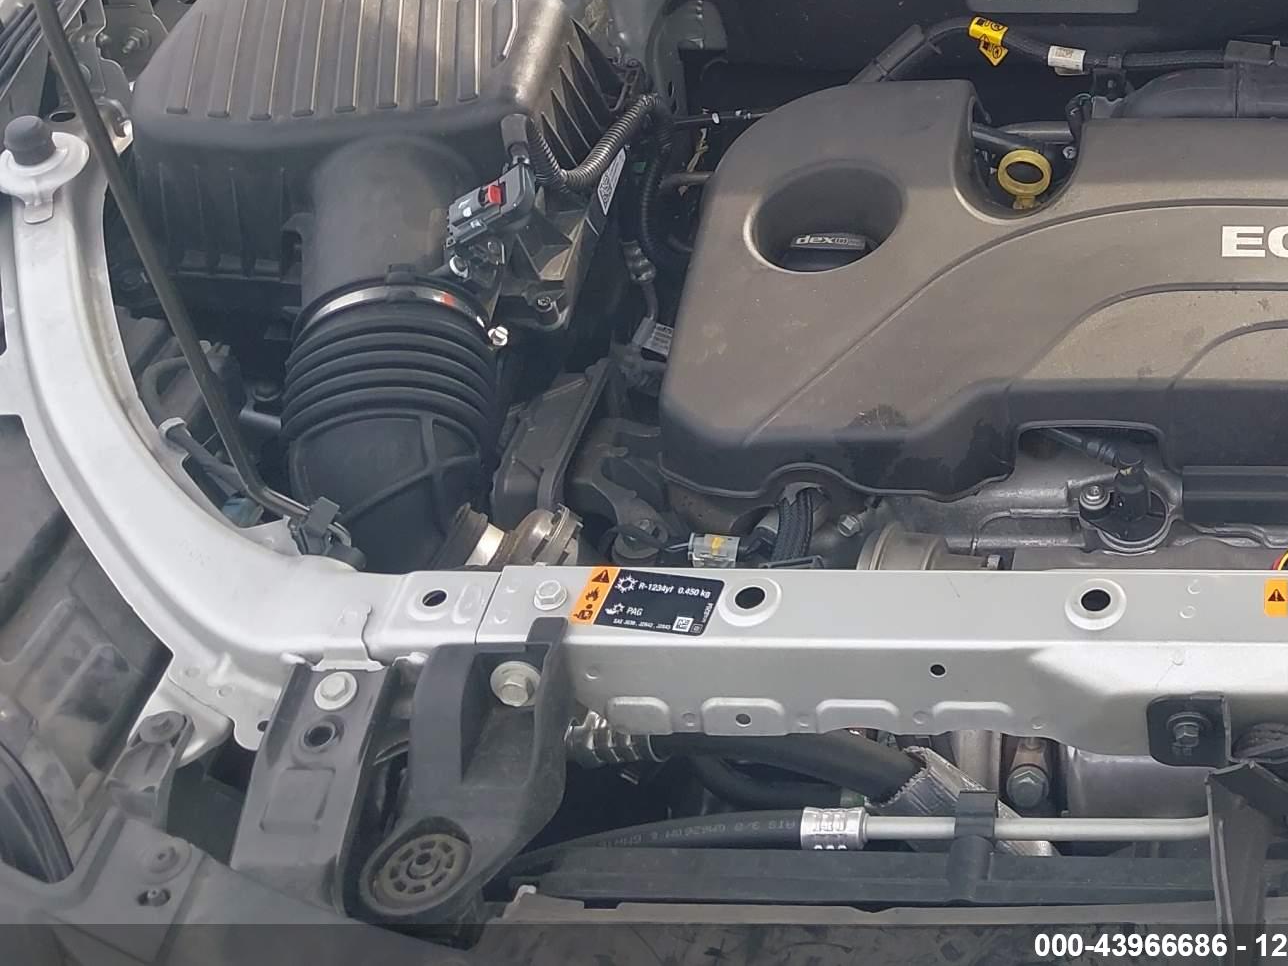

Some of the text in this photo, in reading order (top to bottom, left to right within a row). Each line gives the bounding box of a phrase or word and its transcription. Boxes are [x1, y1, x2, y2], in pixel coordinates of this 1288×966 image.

[638, 582, 711, 599] R-1234yf 0.450 kg
[626, 607, 643, 616] PAG
